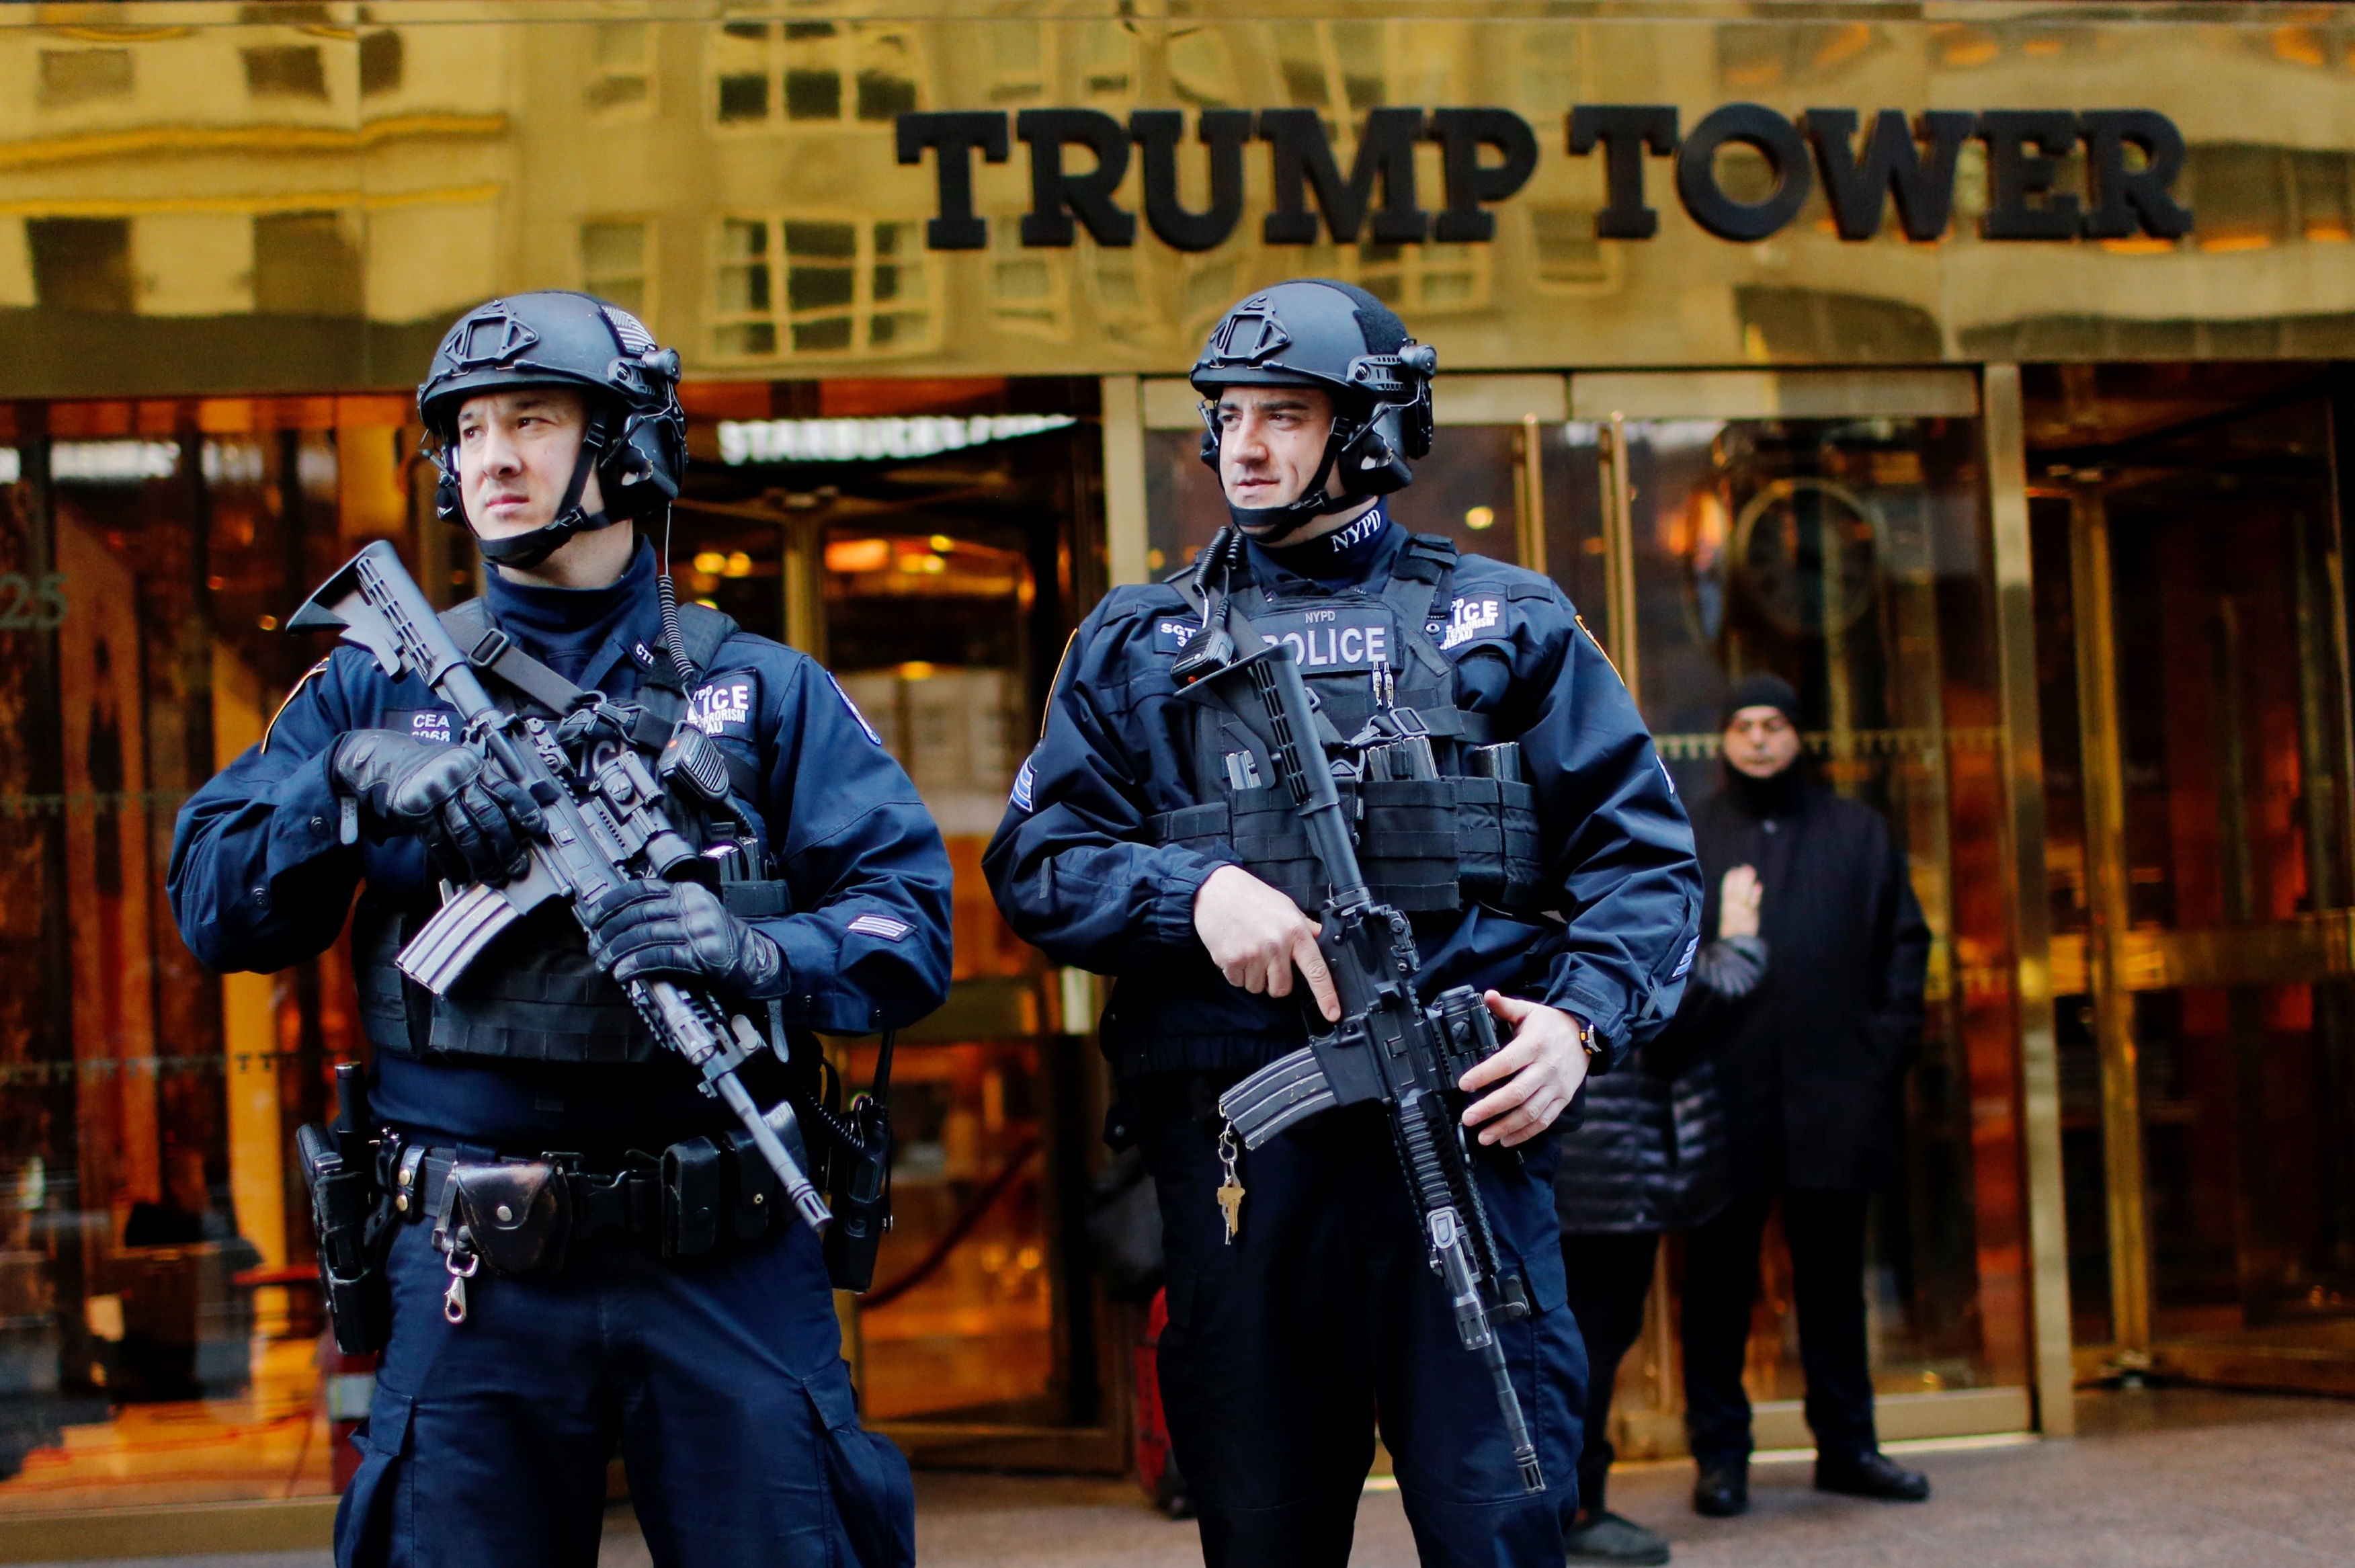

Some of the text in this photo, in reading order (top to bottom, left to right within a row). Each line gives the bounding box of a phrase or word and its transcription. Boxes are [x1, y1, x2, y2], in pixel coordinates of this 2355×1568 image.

[896, 102, 2194, 252] TRUMP TOWER
[1331, 509, 1381, 552] NYPD
[1305, 610, 1336, 624] NYPD
[1161, 623, 1196, 638] SGT
[1440, 629, 1473, 650] REAU
[413, 714, 450, 728] CEA
